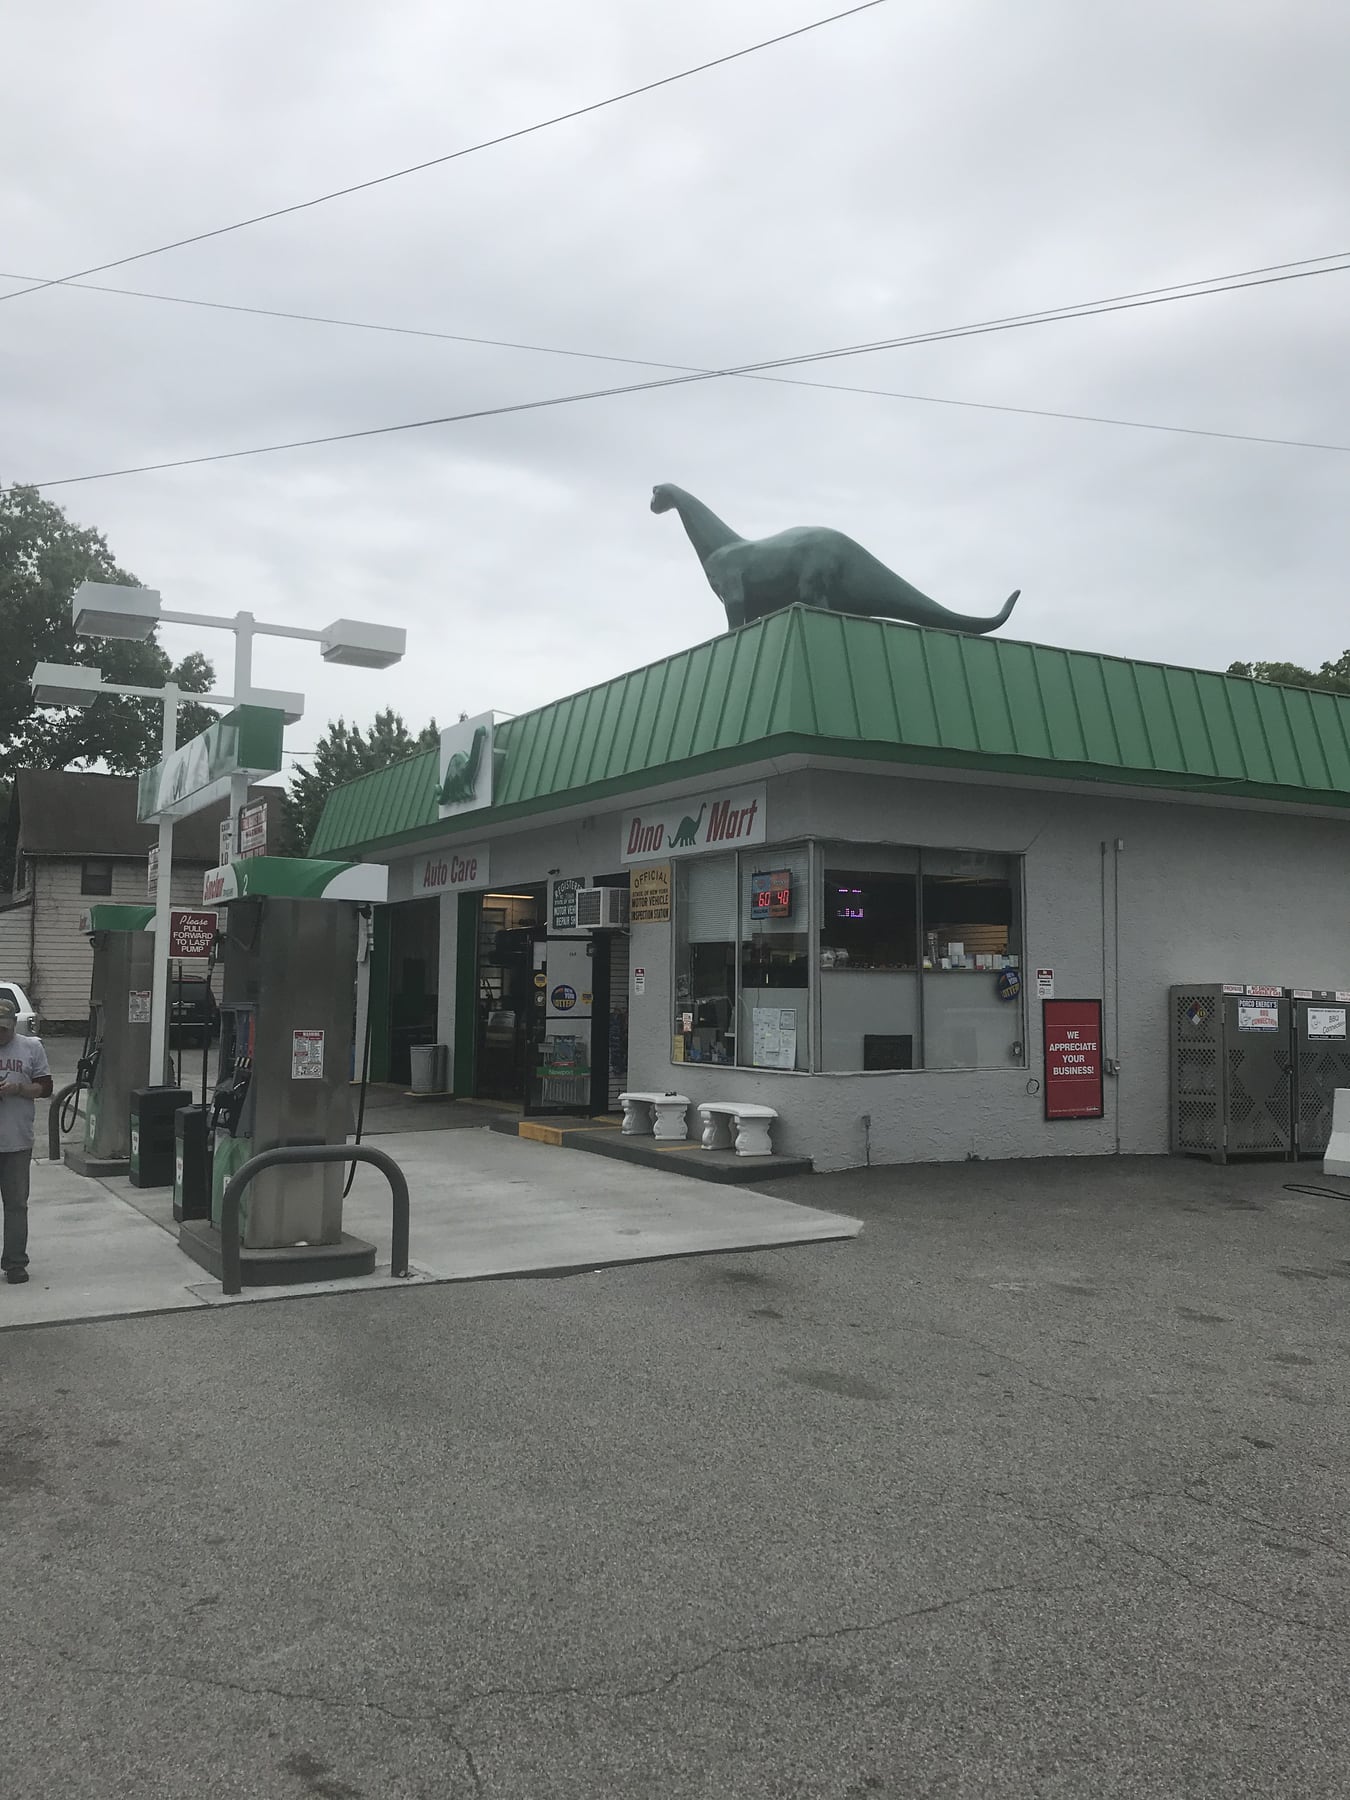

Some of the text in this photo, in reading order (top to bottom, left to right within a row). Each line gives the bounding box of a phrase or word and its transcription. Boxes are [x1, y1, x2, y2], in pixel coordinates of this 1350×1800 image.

[626, 799, 758, 855] Dino Mart
[423, 855, 477, 888] Auto Care
[634, 870, 668, 888] OFFICIAL
[243, 874, 249, 896] 2
[631, 894, 669, 908] MOTOR VEHICLE
[758, 892, 770, 907] 60
[777, 889, 790, 905] 40
[179, 915, 209, 925] Please
[631, 908, 669, 921] INSPECTION STATION
[173, 931, 213, 940] FORWARD
[181, 945, 204, 953] PUMP
[1328, 1014, 1340, 1023] BBQ
[1067, 1031, 1080, 1040] WE
[1049, 1042, 1097, 1052] APPRECIATE
[1062, 1054, 1085, 1064] YOUR
[1053, 1066, 1095, 1076] BUSINESS!
